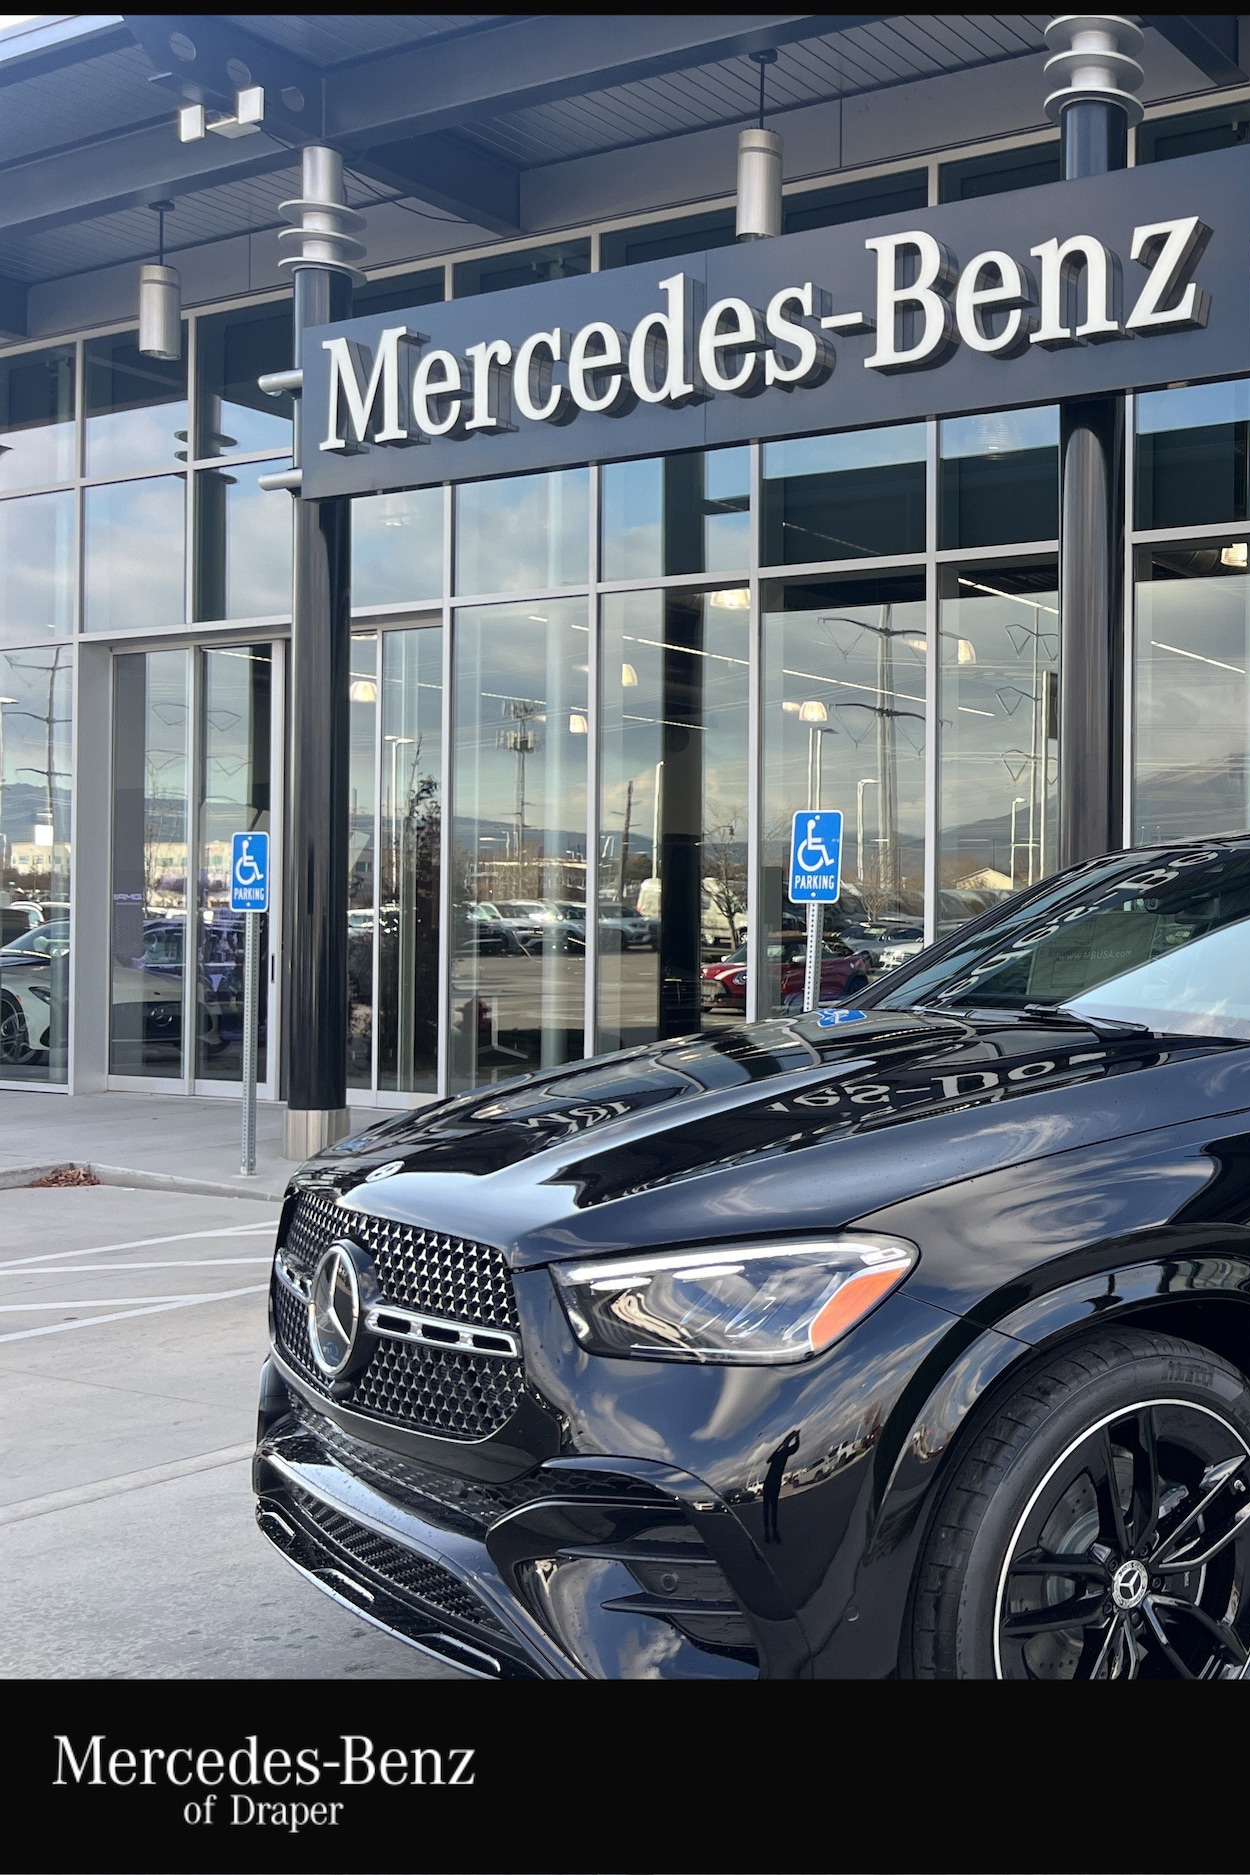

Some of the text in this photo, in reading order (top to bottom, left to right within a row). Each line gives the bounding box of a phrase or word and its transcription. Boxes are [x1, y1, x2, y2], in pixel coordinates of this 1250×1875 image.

[319, 216, 1204, 453] Mercedes-Benz
[794, 874, 836, 890] PARKING
[233, 887, 265, 901] PARKING
